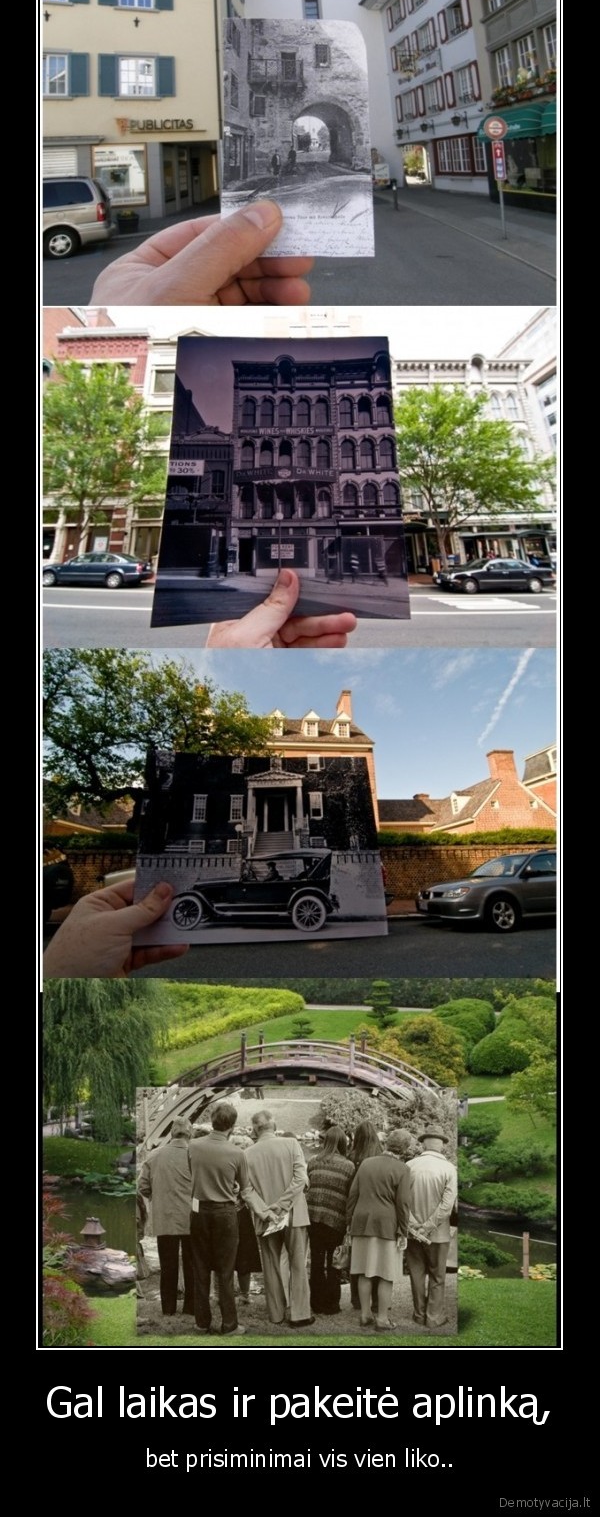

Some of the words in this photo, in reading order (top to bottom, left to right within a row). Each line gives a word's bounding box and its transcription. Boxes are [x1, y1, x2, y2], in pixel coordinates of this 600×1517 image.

[129, 118, 194, 131] PUBLICITAS
[259, 427, 280, 435] WINES
[285, 427, 315, 435] WHISKIES
